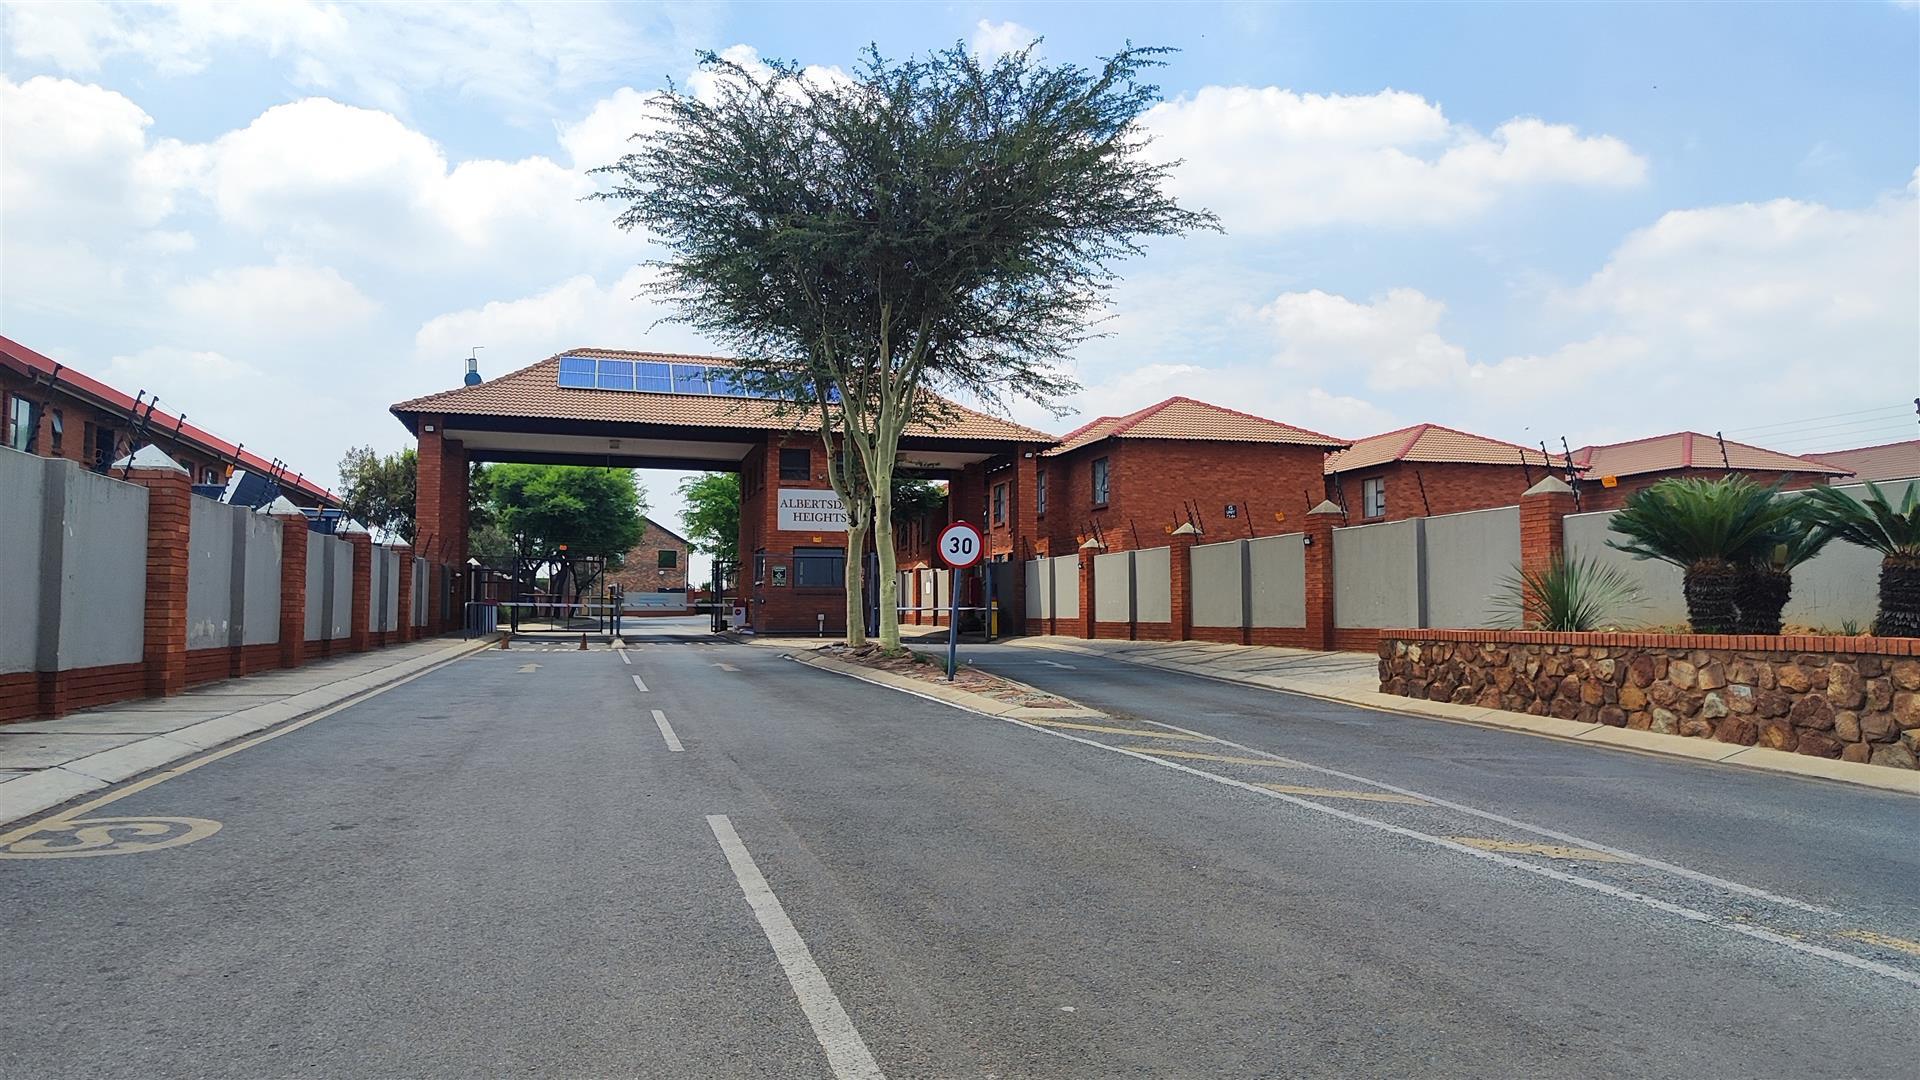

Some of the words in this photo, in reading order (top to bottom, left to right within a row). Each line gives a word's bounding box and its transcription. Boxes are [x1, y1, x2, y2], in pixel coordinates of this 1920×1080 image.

[780, 499, 845, 510] ALBERTSD
[792, 512, 847, 523] HEIGHTS
[949, 536, 972, 555] 30
